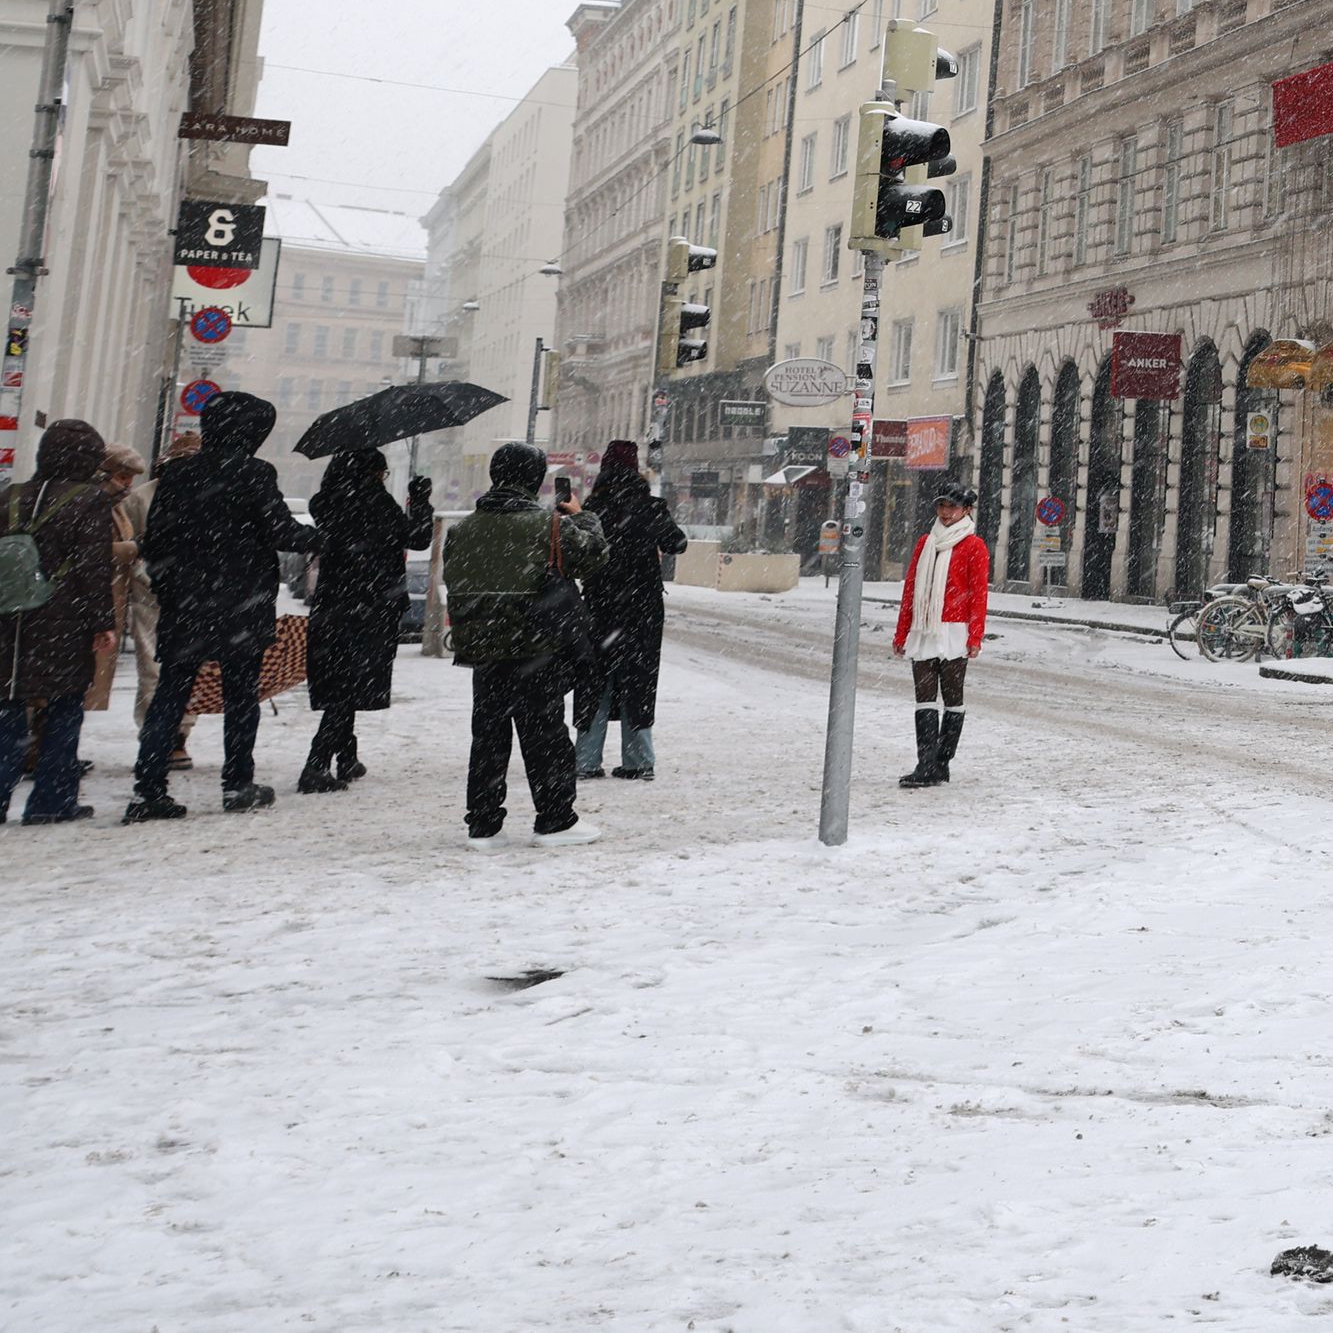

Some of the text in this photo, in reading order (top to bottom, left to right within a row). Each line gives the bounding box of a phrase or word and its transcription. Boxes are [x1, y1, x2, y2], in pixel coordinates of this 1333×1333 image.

[179, 121, 287, 138] ZARA HOME
[906, 201, 921, 212] 22
[180, 249, 218, 261] PAPER
[231, 252, 253, 262] TEA
[1127, 358, 1167, 368] ANKER
[771, 381, 843, 393] SUZANNE
